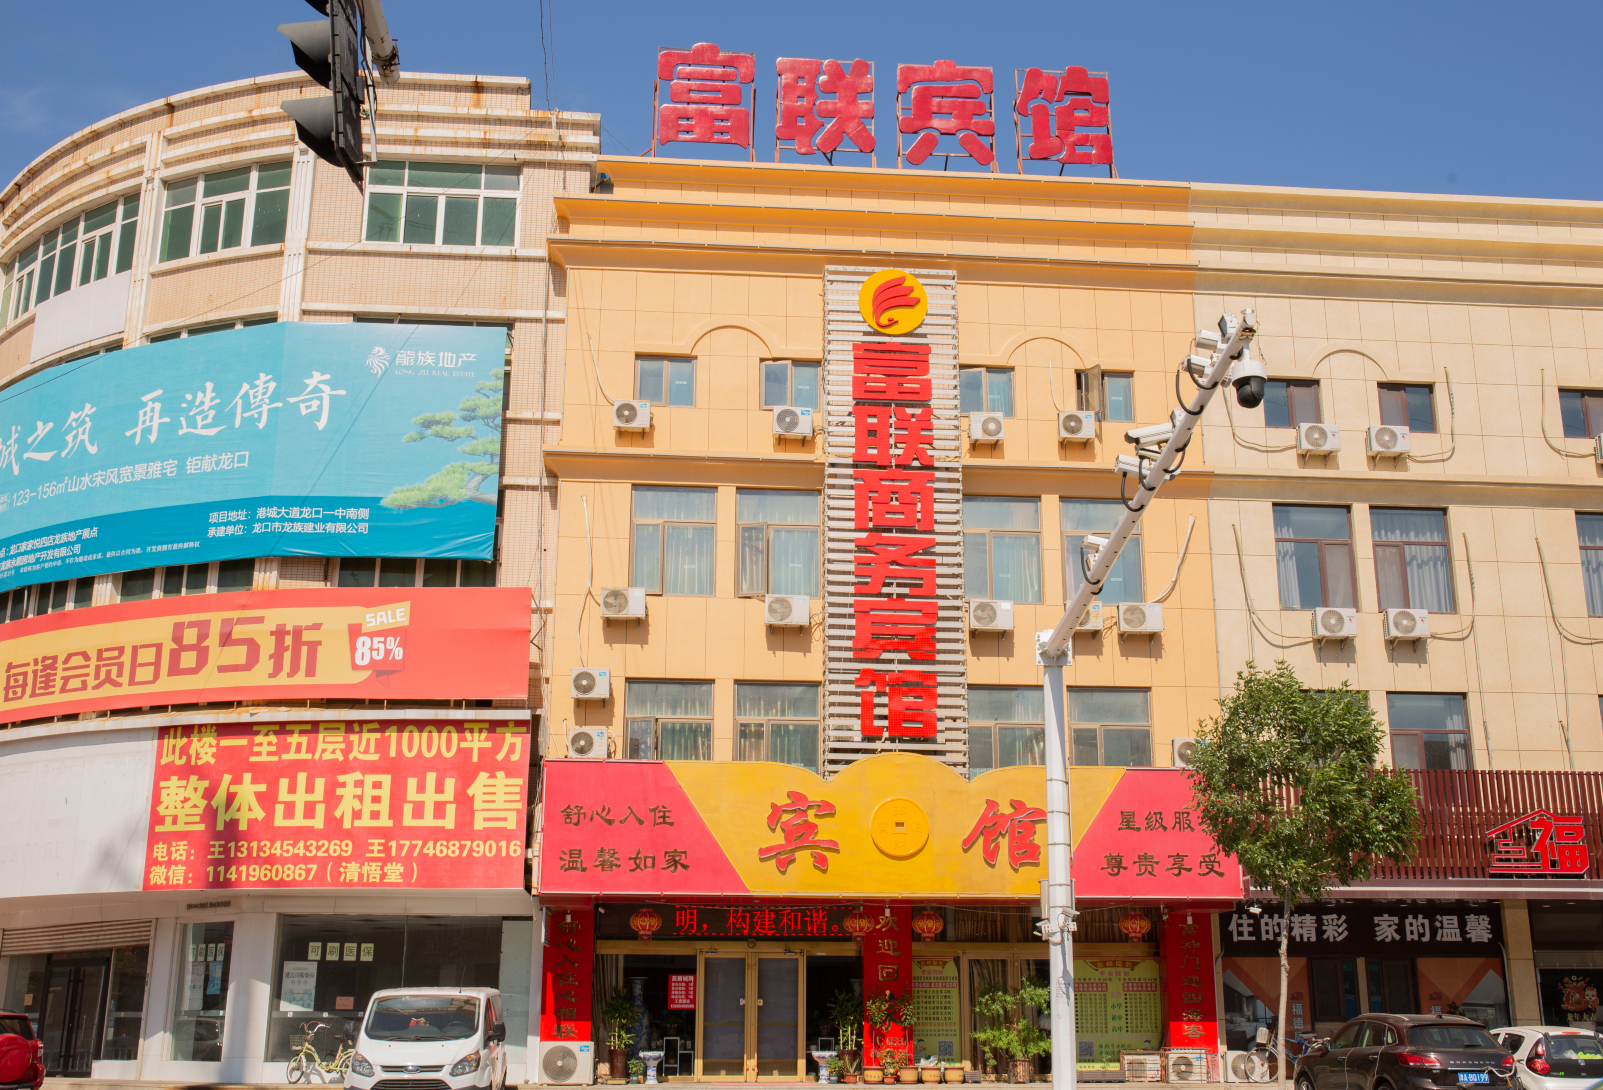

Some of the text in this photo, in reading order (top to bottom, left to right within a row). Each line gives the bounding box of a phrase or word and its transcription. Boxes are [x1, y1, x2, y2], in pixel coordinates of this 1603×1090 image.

[658, 42, 1112, 166] 富联宾馆
[452, 370, 476, 378] ESTATE
[186, 450, 250, 474] 钜献龙口
[852, 342, 939, 738] 富联商务宾馆
[365, 606, 408, 628] SALE
[3, 615, 323, 701] 每逢会员日85折
[354, 635, 404, 667] 85%
[160, 720, 527, 766] 此楼一至五层近1000平方
[154, 770, 524, 833] 整体出租出售
[560, 803, 675, 828] 舒心入住
[758, 790, 1048, 872] 宾 馆
[366, 839, 522, 858] 王17746879016
[559, 846, 691, 873] 温馨如家
[1100, 851, 1225, 878] 尊贵享受
[1227, 913, 1494, 943] 住的精彩 家的温馨
[310, 945, 373, 957] 可刷医保
